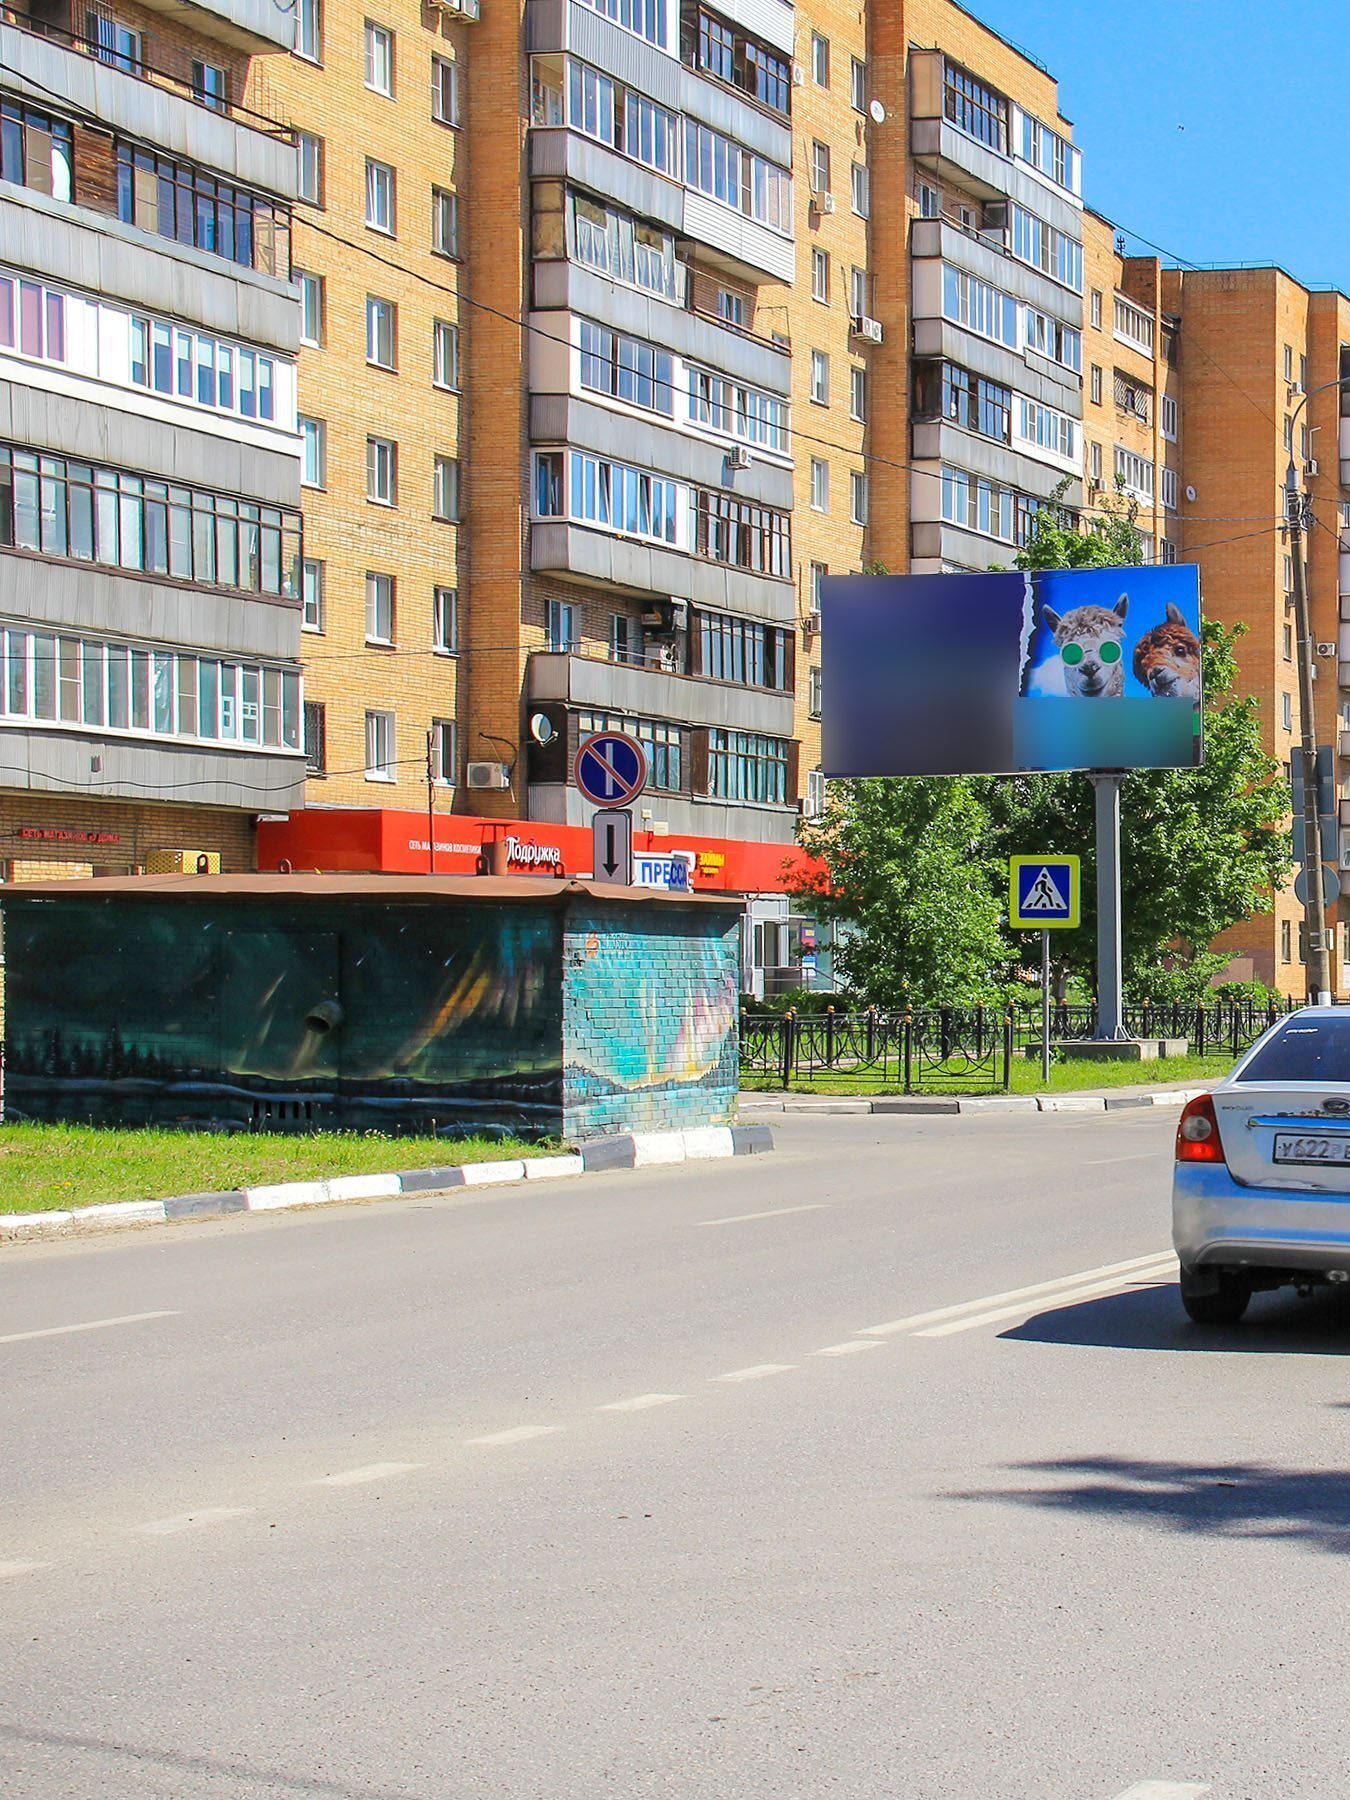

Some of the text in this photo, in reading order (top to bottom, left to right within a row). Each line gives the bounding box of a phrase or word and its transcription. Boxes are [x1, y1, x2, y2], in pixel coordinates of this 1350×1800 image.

[408, 839, 422, 850] СЕТЬ
[506, 836, 561, 866] Подружка
[641, 861, 688, 885] ПРЕССА
